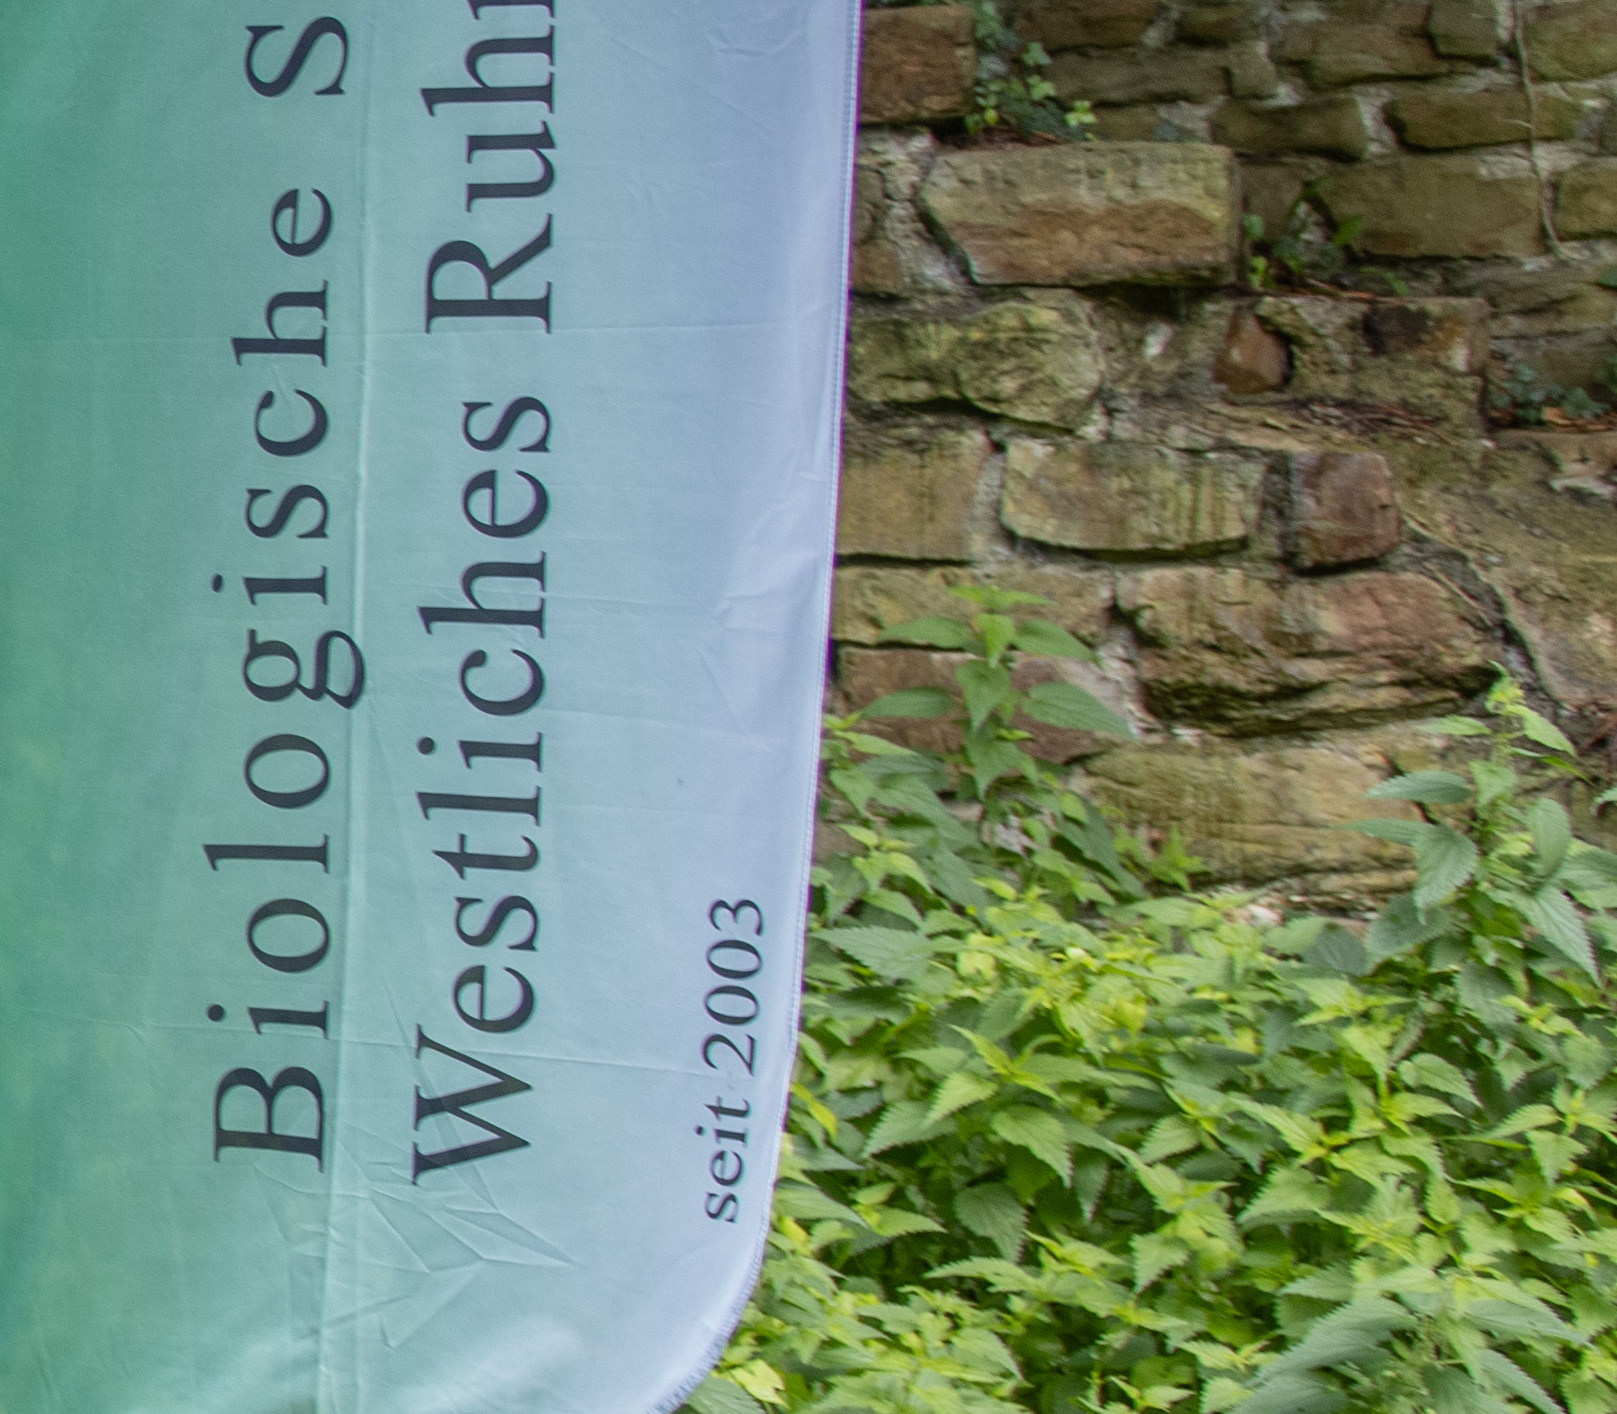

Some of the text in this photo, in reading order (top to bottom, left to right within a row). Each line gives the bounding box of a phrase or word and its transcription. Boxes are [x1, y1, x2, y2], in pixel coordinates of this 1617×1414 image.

[203, 188, 367, 1173] Biologische
[410, 396, 552, 1187] Westliches
[695, 899, 764, 1223] seit 2003
